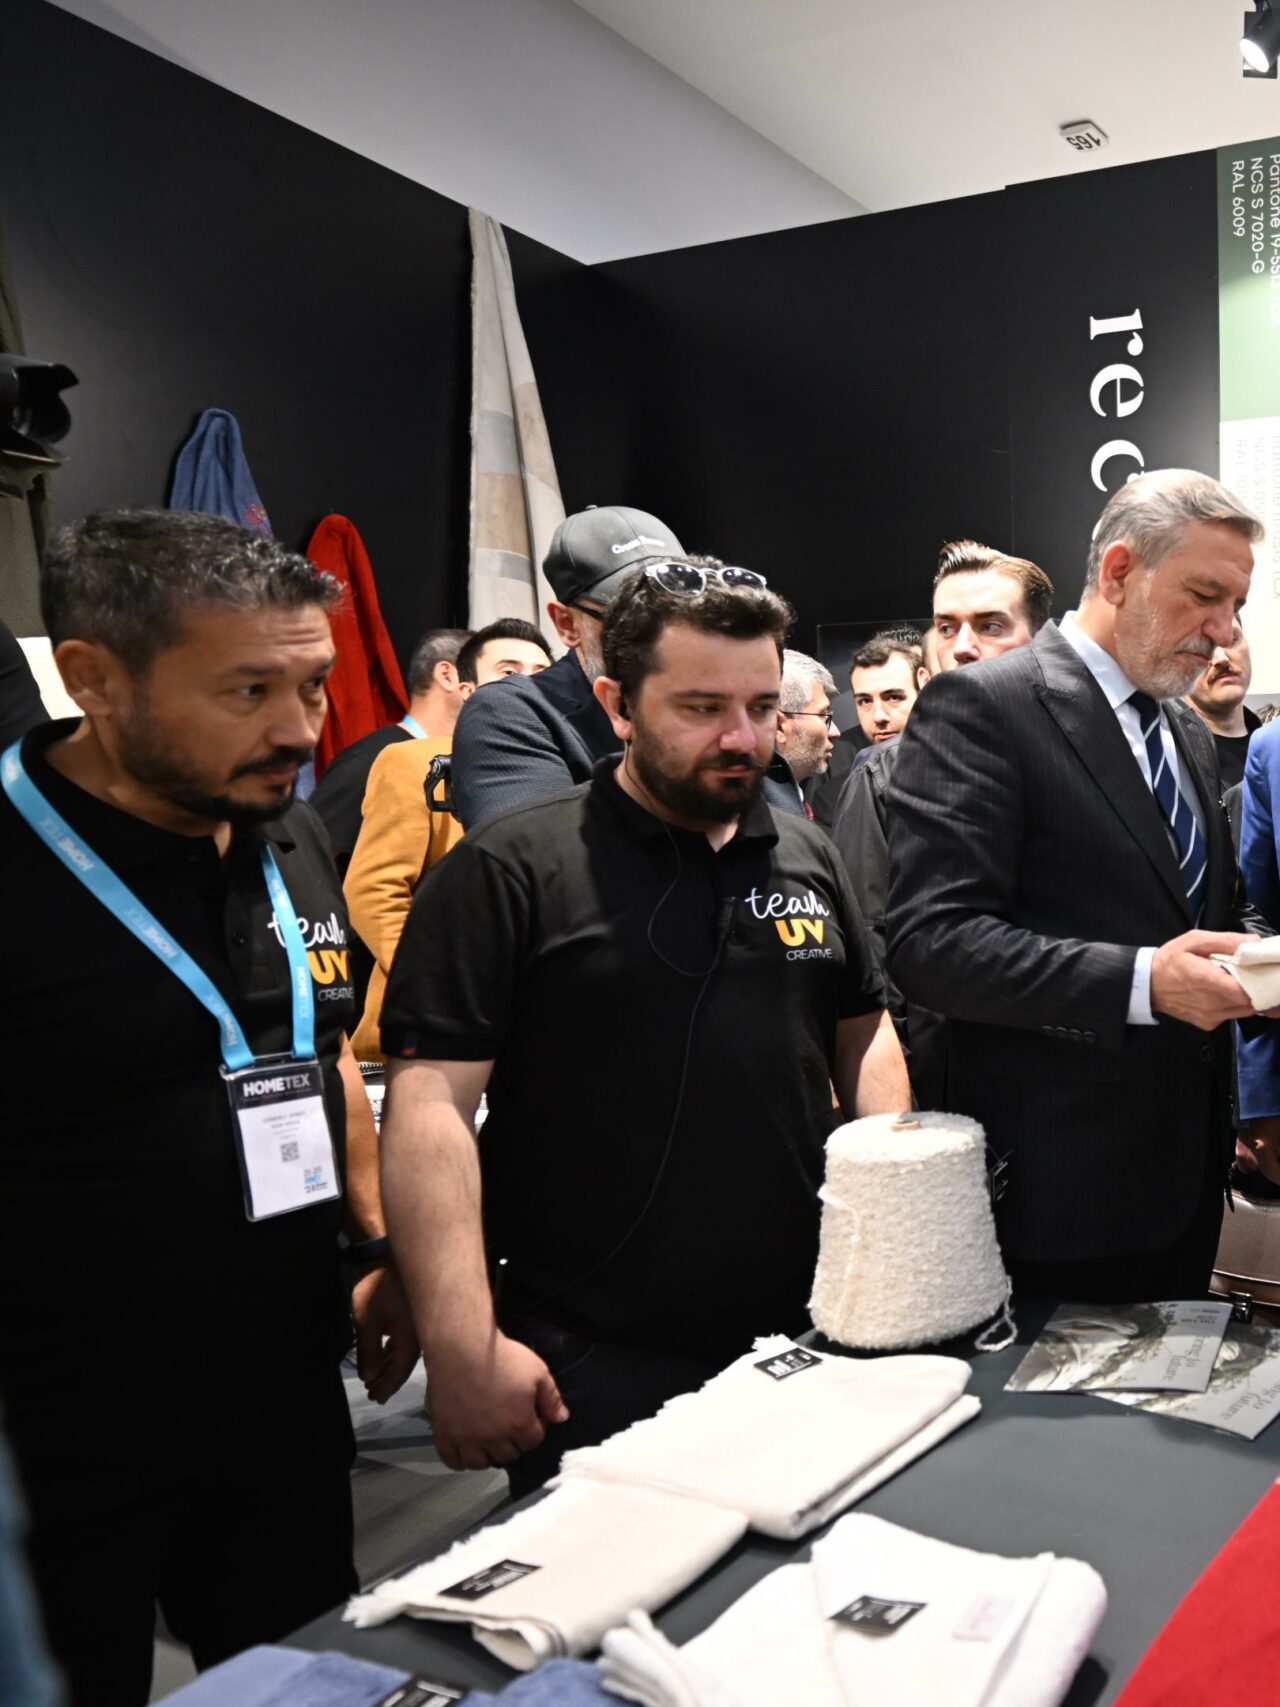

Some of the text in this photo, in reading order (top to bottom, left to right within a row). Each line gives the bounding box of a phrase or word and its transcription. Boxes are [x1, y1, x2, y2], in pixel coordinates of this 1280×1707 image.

[1065, 132, 1101, 150] 165
[1232, 160, 1246, 237] RAL 6009
[1250, 156, 1265, 275] NCS S 7020-G
[745, 887, 829, 919] team
[775, 918, 824, 947] UV
[306, 950, 348, 985] UV
[786, 948, 833, 961] CREATIVE
[243, 1072, 311, 1097] HOMETEX
